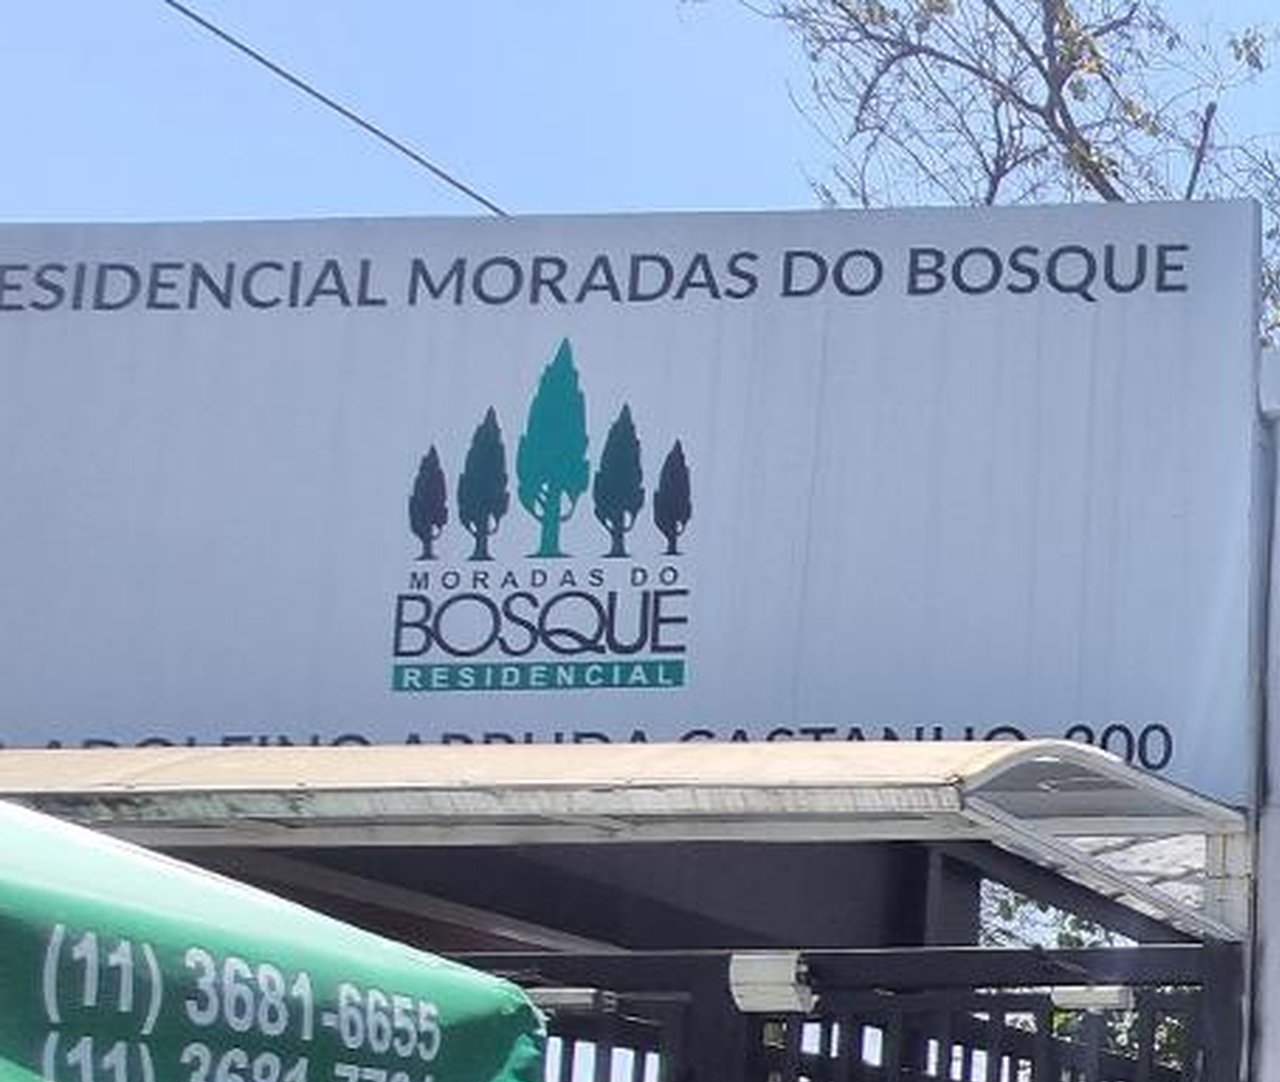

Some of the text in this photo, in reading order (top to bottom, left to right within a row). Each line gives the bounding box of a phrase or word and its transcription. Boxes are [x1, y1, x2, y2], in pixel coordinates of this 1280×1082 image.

[0, 244, 1189, 310] ESIDENCIAL MORADAS DO BOSQUE
[408, 565, 679, 590] MORADAS DO
[393, 589, 689, 657] BOSQUE
[402, 665, 673, 689] RESIDENCIAL
[43, 923, 441, 1061] (11) 3681-6655
